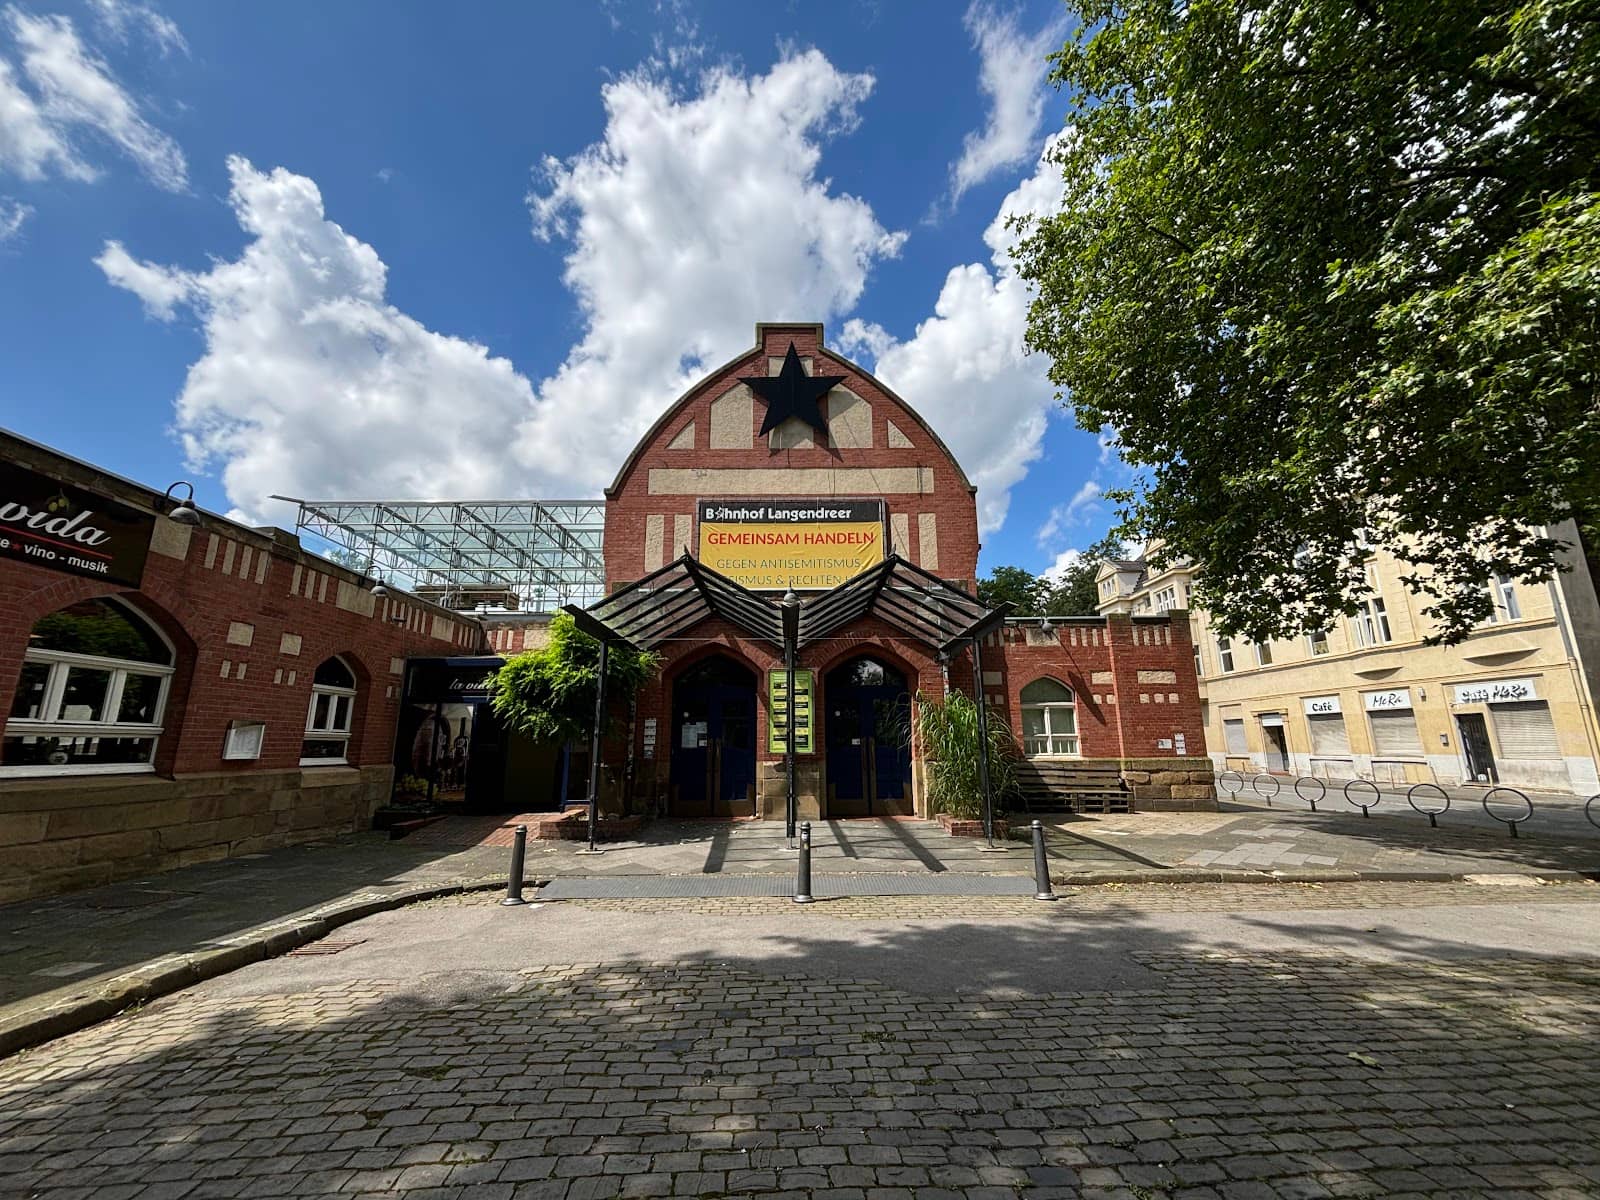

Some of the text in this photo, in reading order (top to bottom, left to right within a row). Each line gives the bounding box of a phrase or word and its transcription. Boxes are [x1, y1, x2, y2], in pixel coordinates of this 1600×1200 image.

[767, 507, 852, 521] Langendreer
[707, 532, 874, 545] GEMEINSAM HANDELN
[24, 544, 56, 560] vino
[67, 556, 109, 573] musik
[716, 559, 757, 569] GEGEN
[775, 575, 784, 585] &
[788, 575, 841, 585] RECHTEN
[1312, 702, 1333, 712] Café
